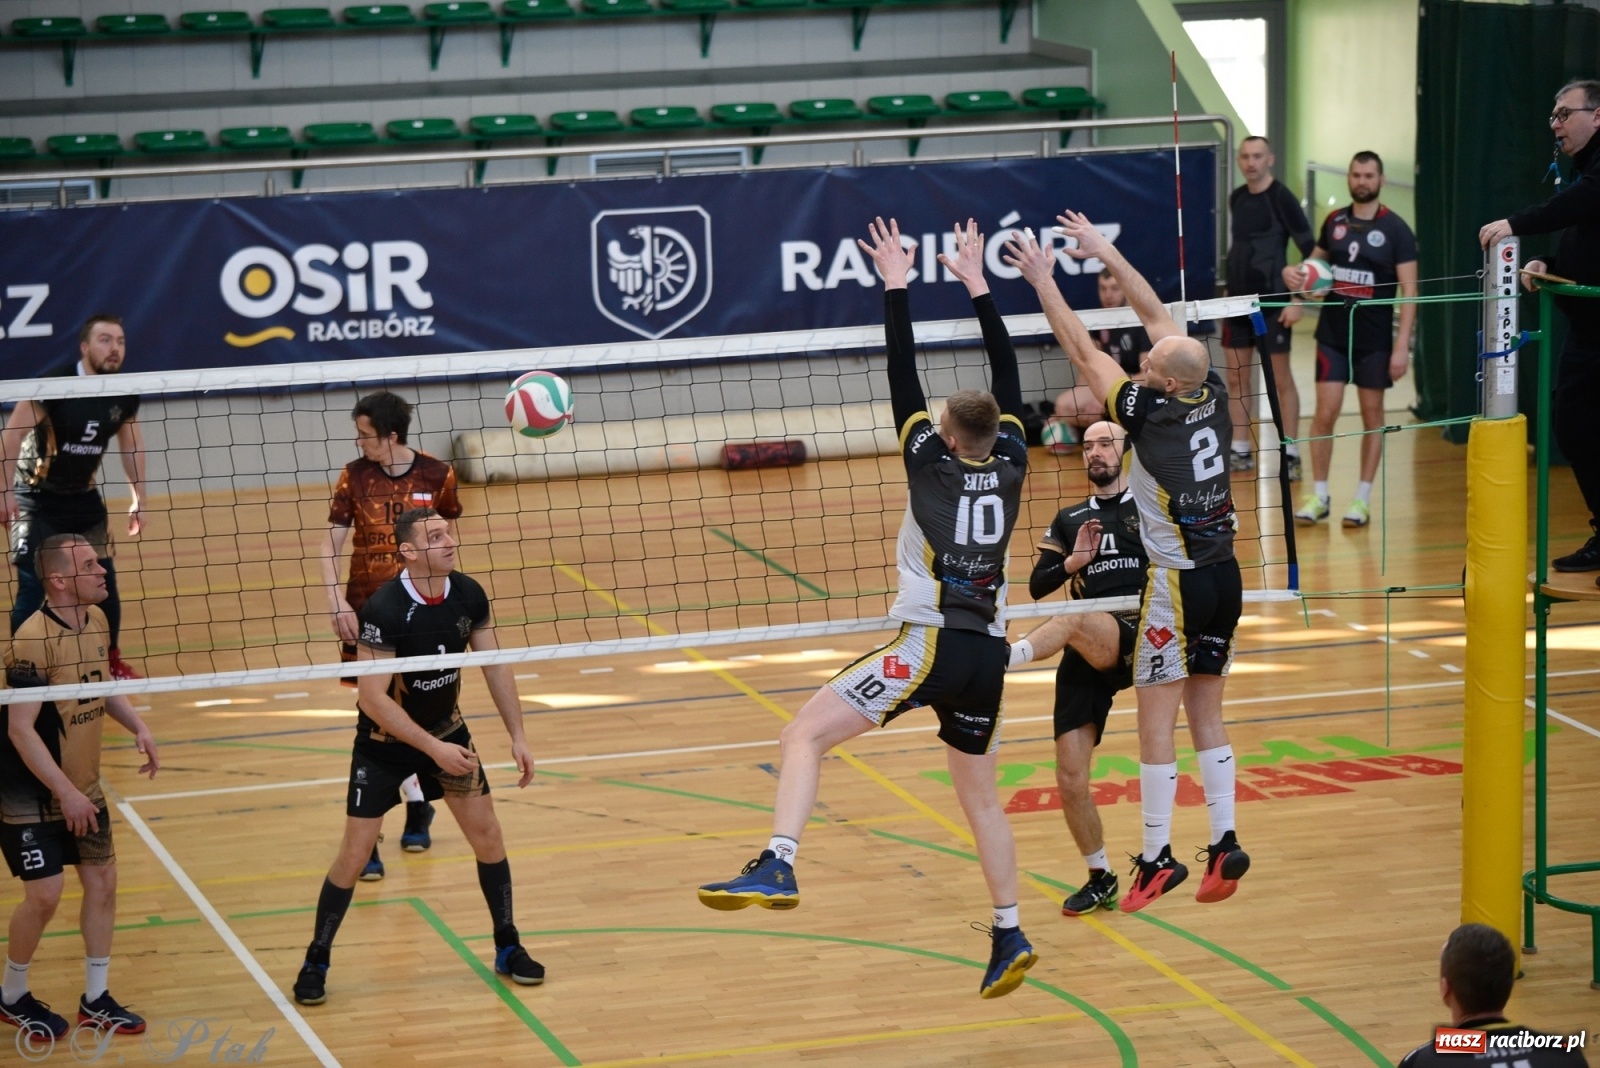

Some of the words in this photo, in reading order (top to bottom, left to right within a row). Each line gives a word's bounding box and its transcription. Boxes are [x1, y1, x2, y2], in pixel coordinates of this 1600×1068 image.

[1348, 241, 1360, 263] 9
[220, 241, 434, 319] OSiR
[0, 284, 53, 339] Z
[308, 313, 435, 342] RACIBÓRZ
[1185, 399, 1217, 425] ENTER
[81, 421, 100, 442] 5
[62, 441, 103, 455] AGROTIM
[1189, 426, 1225, 482] 2
[963, 471, 999, 491] ENTER
[954, 494, 1005, 546] 10
[1087, 557, 1140, 576] AGROTIM
[1151, 654, 1164, 677] 2
[853, 673, 886, 700] 10
[356, 788, 361, 807] 1
[20, 848, 45, 871] 23
